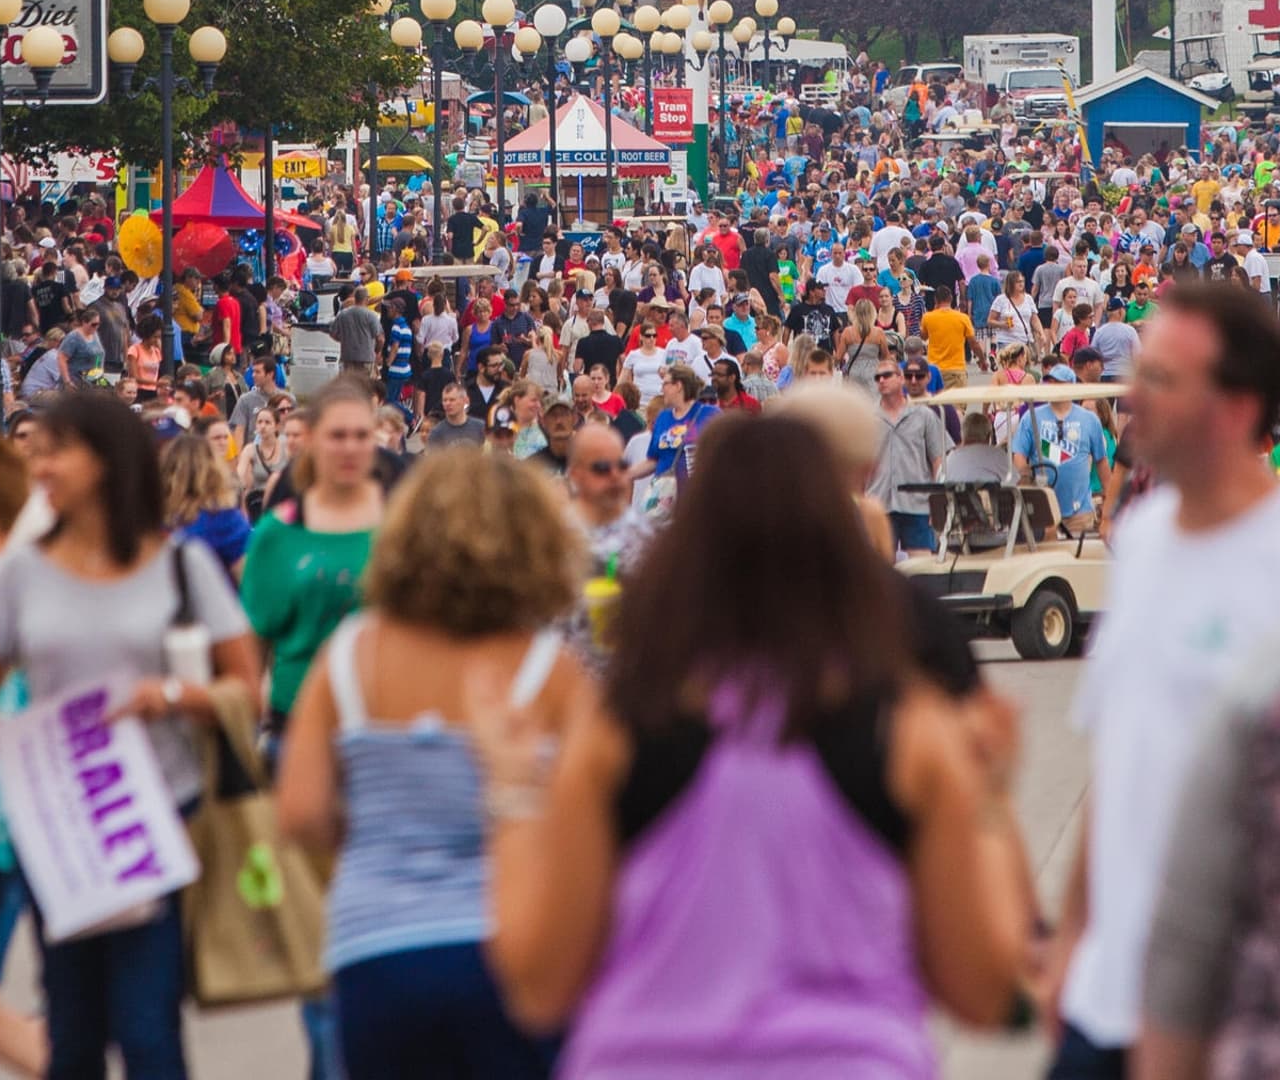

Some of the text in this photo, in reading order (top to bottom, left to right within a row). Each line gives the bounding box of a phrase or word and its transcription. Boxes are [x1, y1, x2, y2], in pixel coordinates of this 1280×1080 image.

[9, 0, 78, 28] Diet
[658, 101, 687, 112] Tram
[659, 113, 687, 125] Stop
[517, 152, 539, 163] BEER
[573, 152, 608, 162] COLD
[620, 151, 666, 162] ROOT BEER
[284, 161, 307, 174] EXIT
[61, 686, 163, 883] BRALEY
